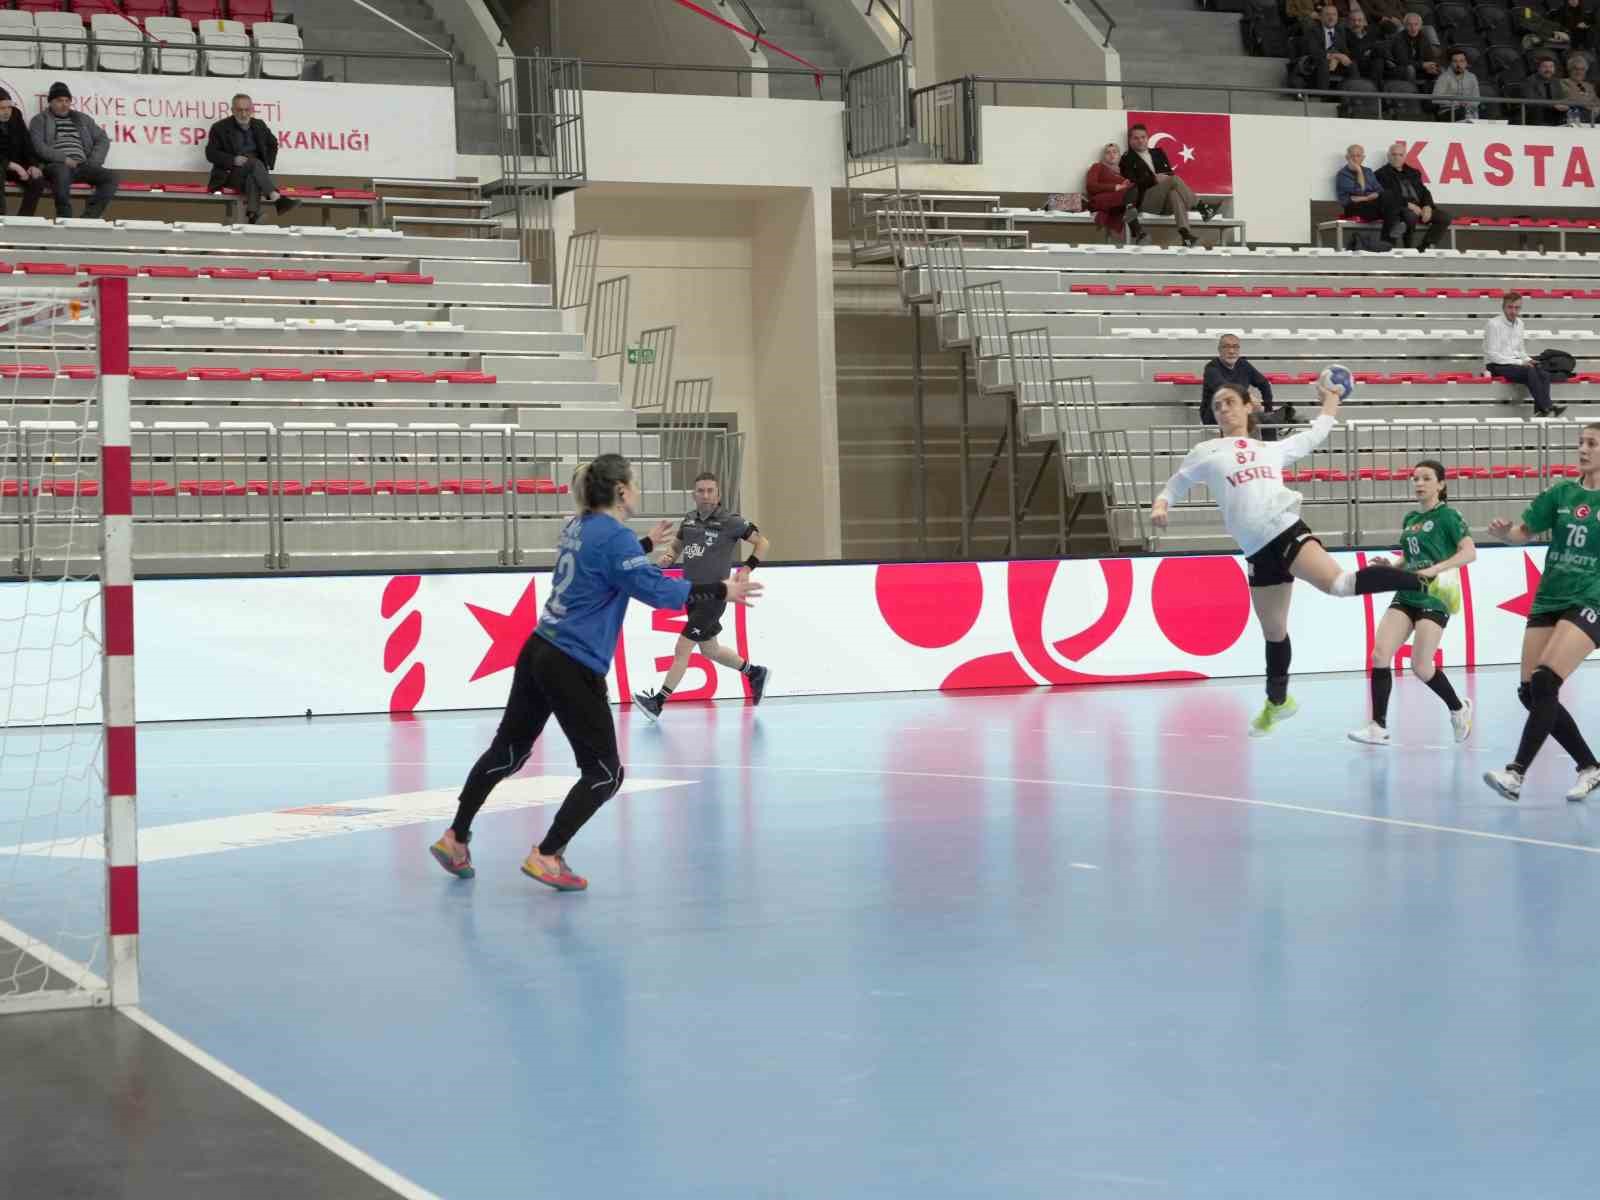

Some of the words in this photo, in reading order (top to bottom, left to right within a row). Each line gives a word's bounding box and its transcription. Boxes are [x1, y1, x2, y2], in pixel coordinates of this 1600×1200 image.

[144, 126, 172, 145] VE
[1236, 451, 1256, 464] 87
[1226, 465, 1277, 488] VESTEL
[1407, 535, 1419, 555] 18
[1566, 523, 1588, 548] 76
